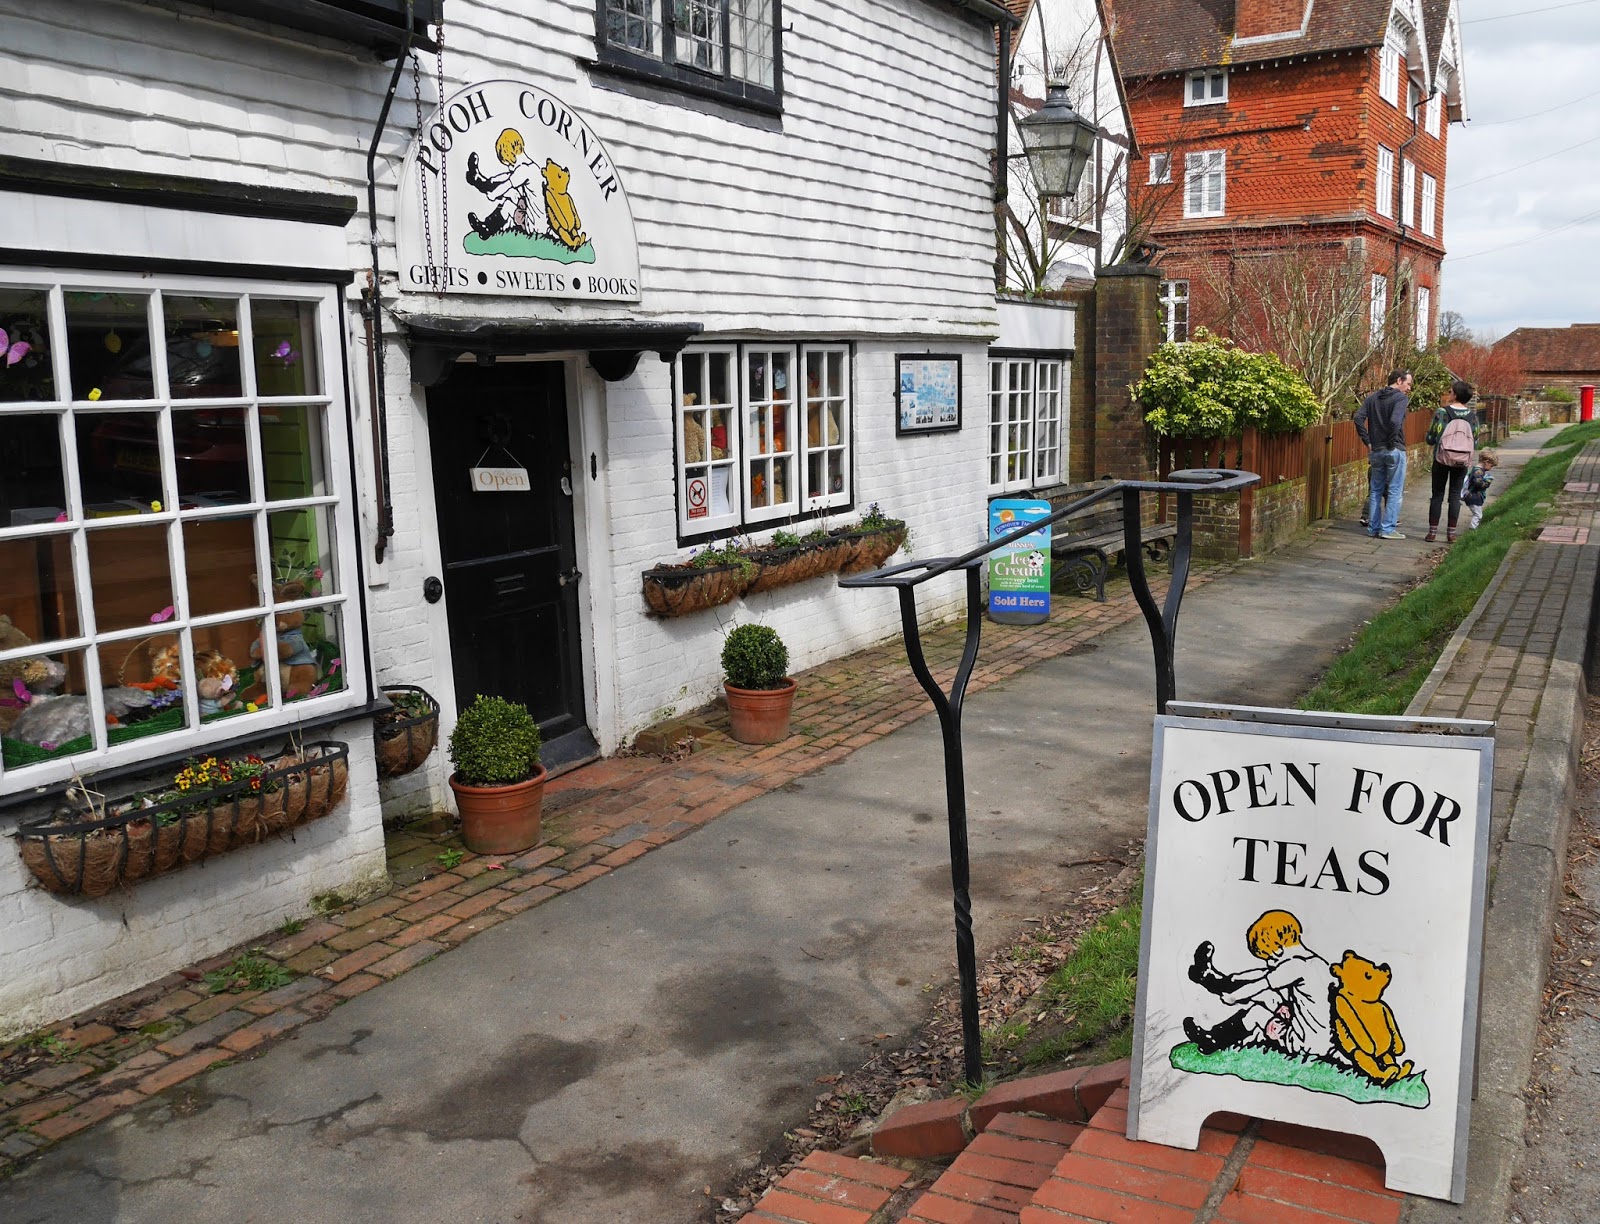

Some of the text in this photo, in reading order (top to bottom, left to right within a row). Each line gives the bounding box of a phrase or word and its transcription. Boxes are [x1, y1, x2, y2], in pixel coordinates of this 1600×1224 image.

[415, 89, 618, 202] POOH CORNER
[409, 264, 637, 296] GIFTS SWEETS BOOKS
[479, 471, 525, 492] Open
[994, 562, 1045, 577] Cream
[1010, 551, 1030, 565] Ice
[994, 596, 1045, 606] Sold Here
[1172, 761, 1462, 847] OPEN FOR
[1232, 836, 1391, 896] TEAS
